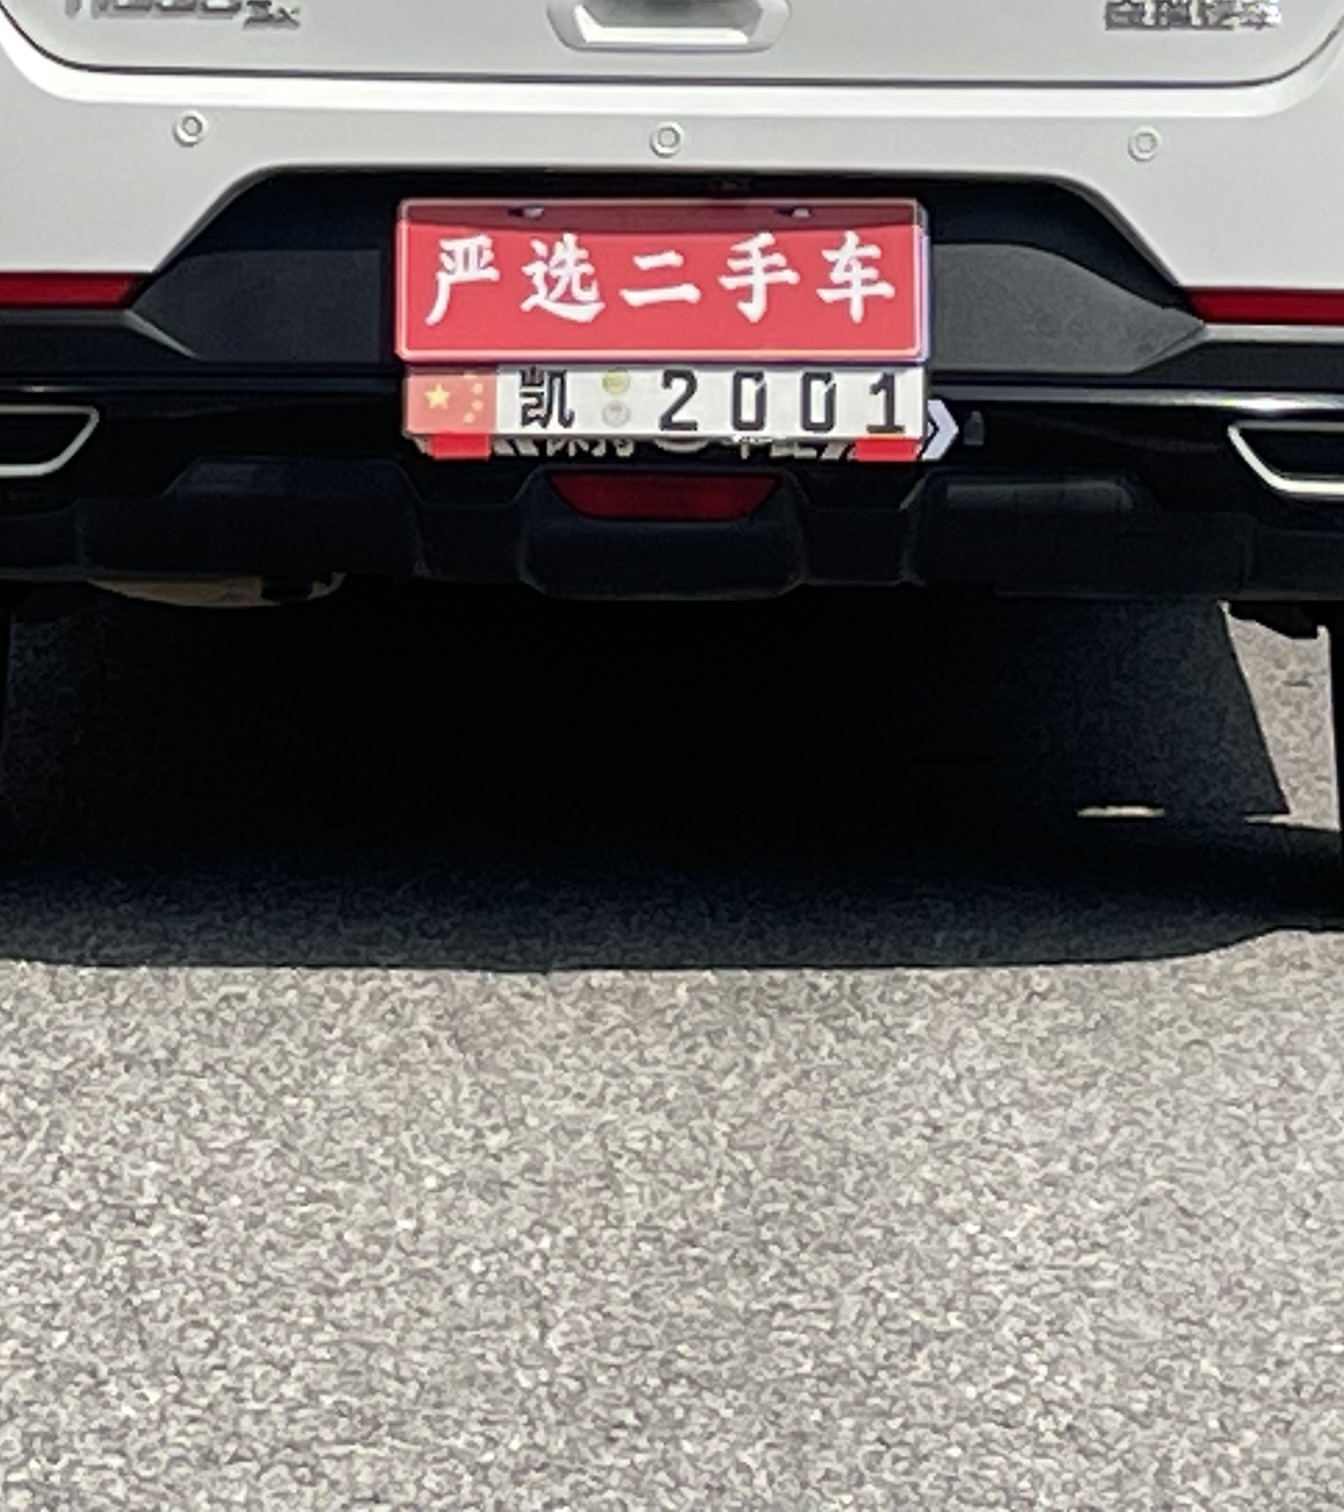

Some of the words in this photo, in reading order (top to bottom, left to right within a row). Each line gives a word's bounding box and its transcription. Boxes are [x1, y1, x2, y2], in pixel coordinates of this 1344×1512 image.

[424, 231, 896, 325] 严选二手车
[659, 369, 906, 434] 2001
